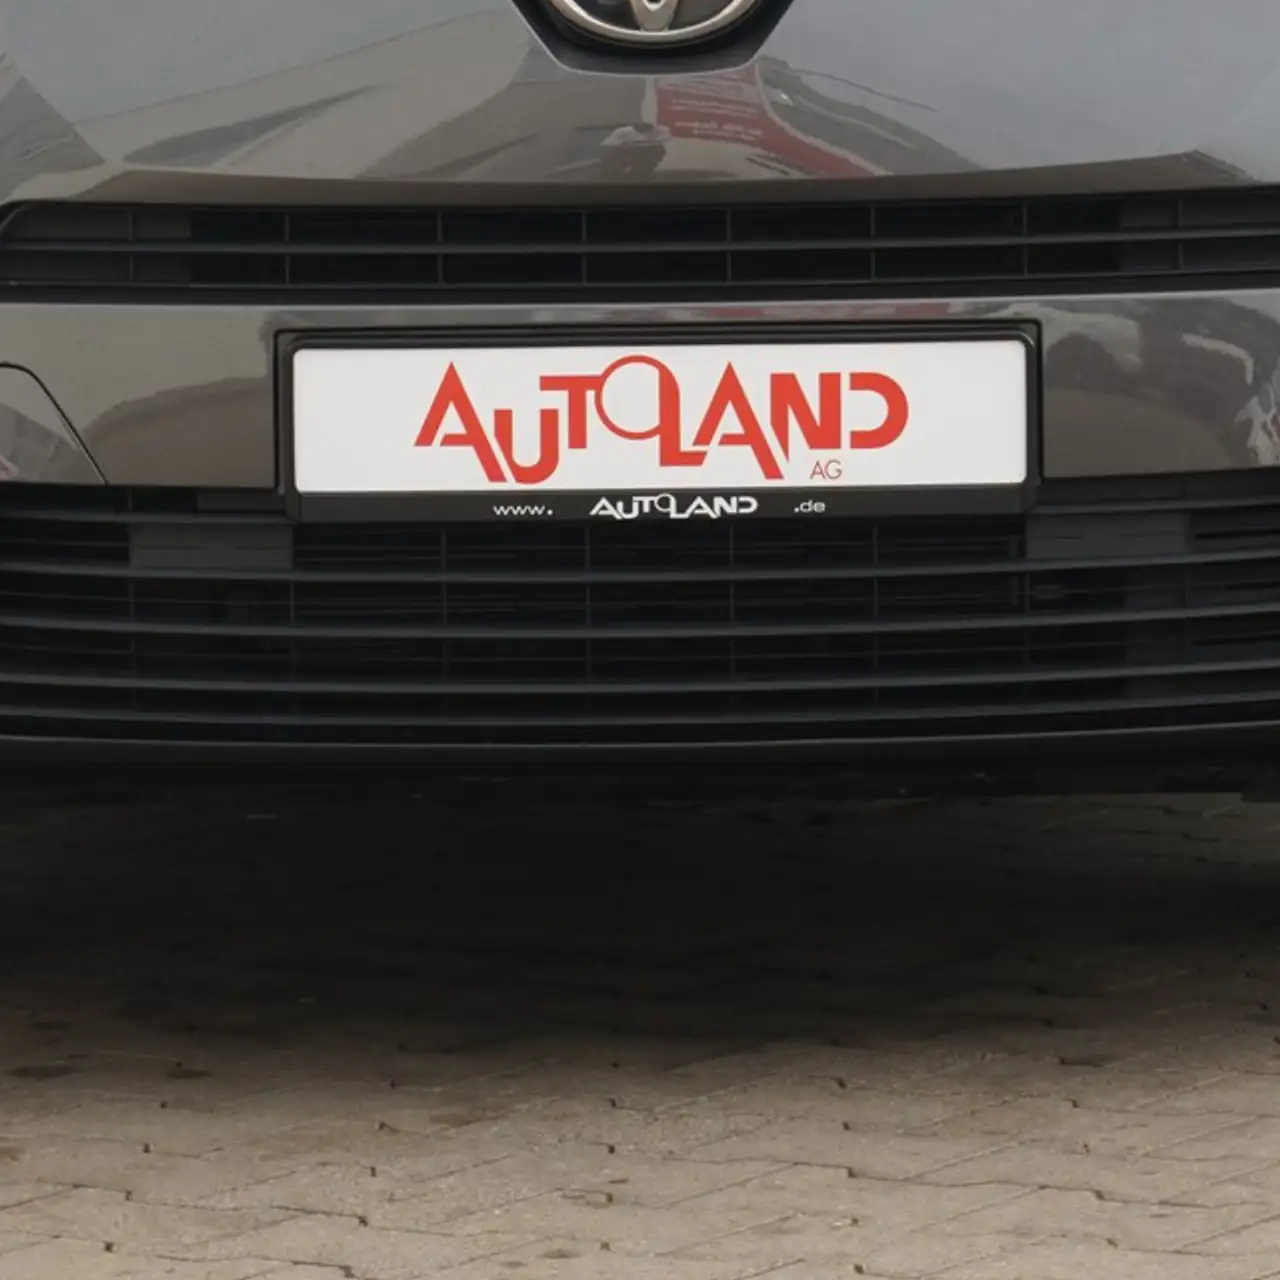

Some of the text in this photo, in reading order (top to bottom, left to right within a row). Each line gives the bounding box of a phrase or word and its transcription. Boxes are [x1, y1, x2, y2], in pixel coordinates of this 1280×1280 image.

[809, 459, 843, 480] AG
[493, 504, 553, 516] www.
[794, 499, 826, 513] .de
